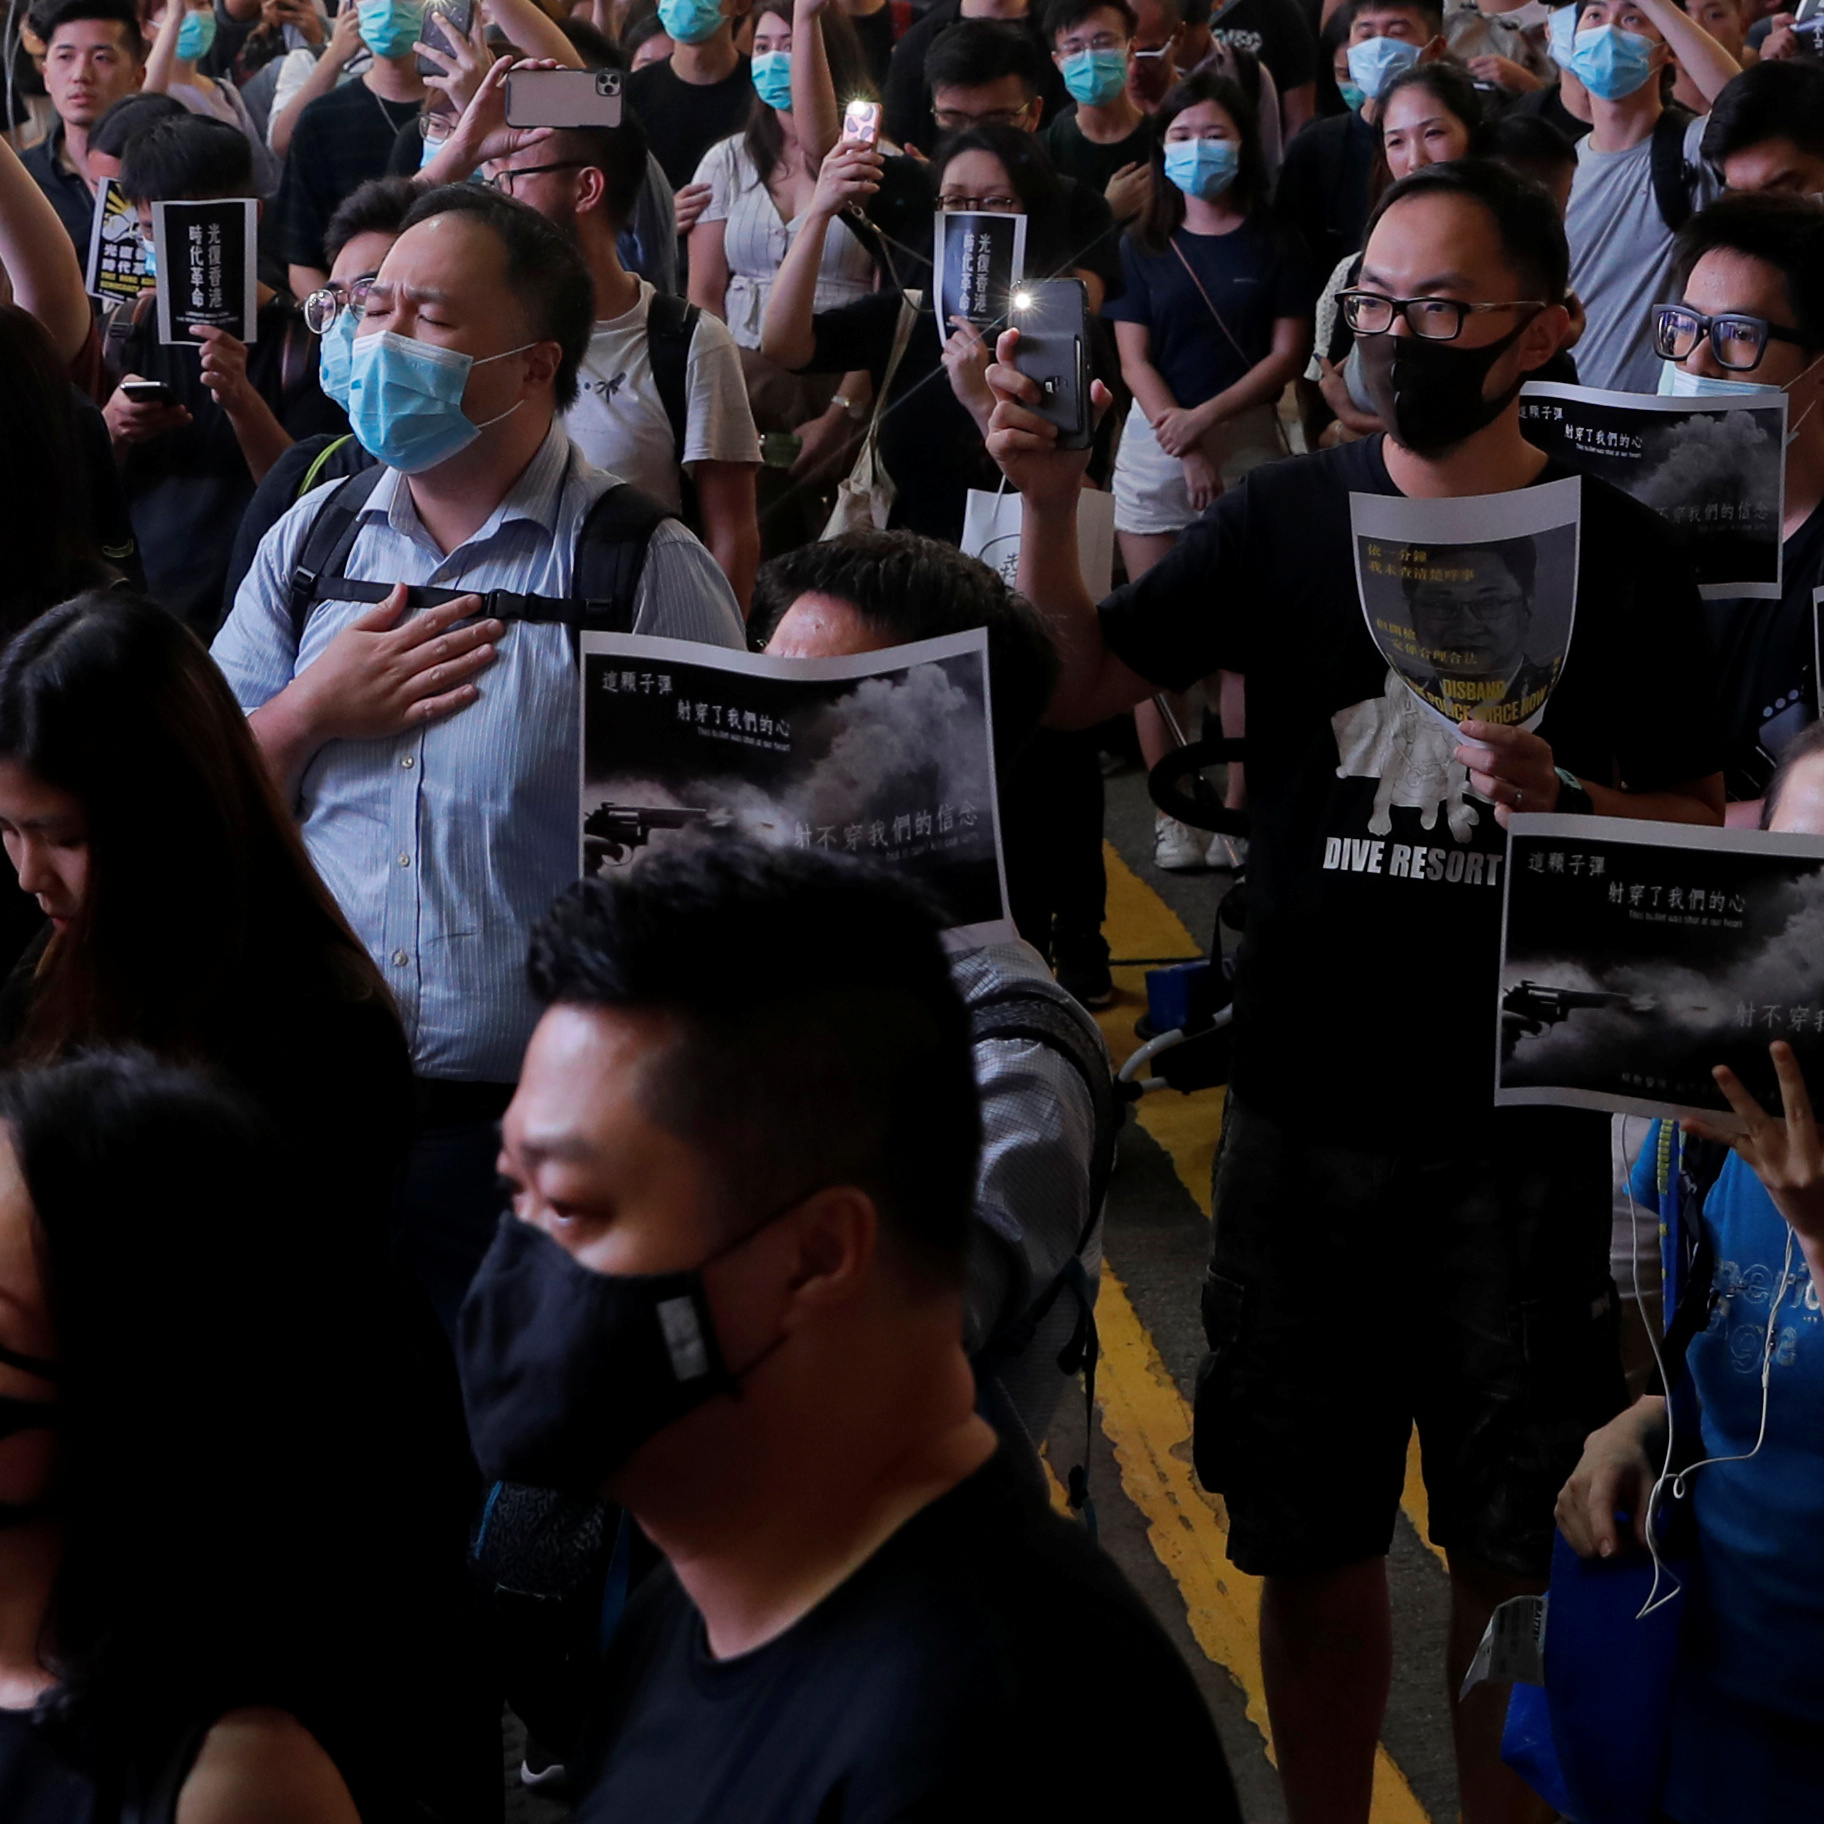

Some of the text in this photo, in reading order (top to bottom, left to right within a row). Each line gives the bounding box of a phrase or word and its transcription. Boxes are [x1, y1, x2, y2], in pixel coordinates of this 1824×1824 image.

[188, 224, 205, 308] 時代革命
[207, 223, 224, 308] 光復香港
[602, 670, 674, 696] 這顆子彈
[1442, 678, 1507, 702] DISBAND
[677, 699, 791, 738] 射穿了我們的心
[1427, 690, 1471, 722] POLICE
[793, 799, 978, 853] 射不穿我們的信念
[1323, 837, 1504, 886] DIVE RESORT
[1526, 851, 1608, 878] 這顆子彈
[1607, 880, 1745, 915] 射穿了我們的心
